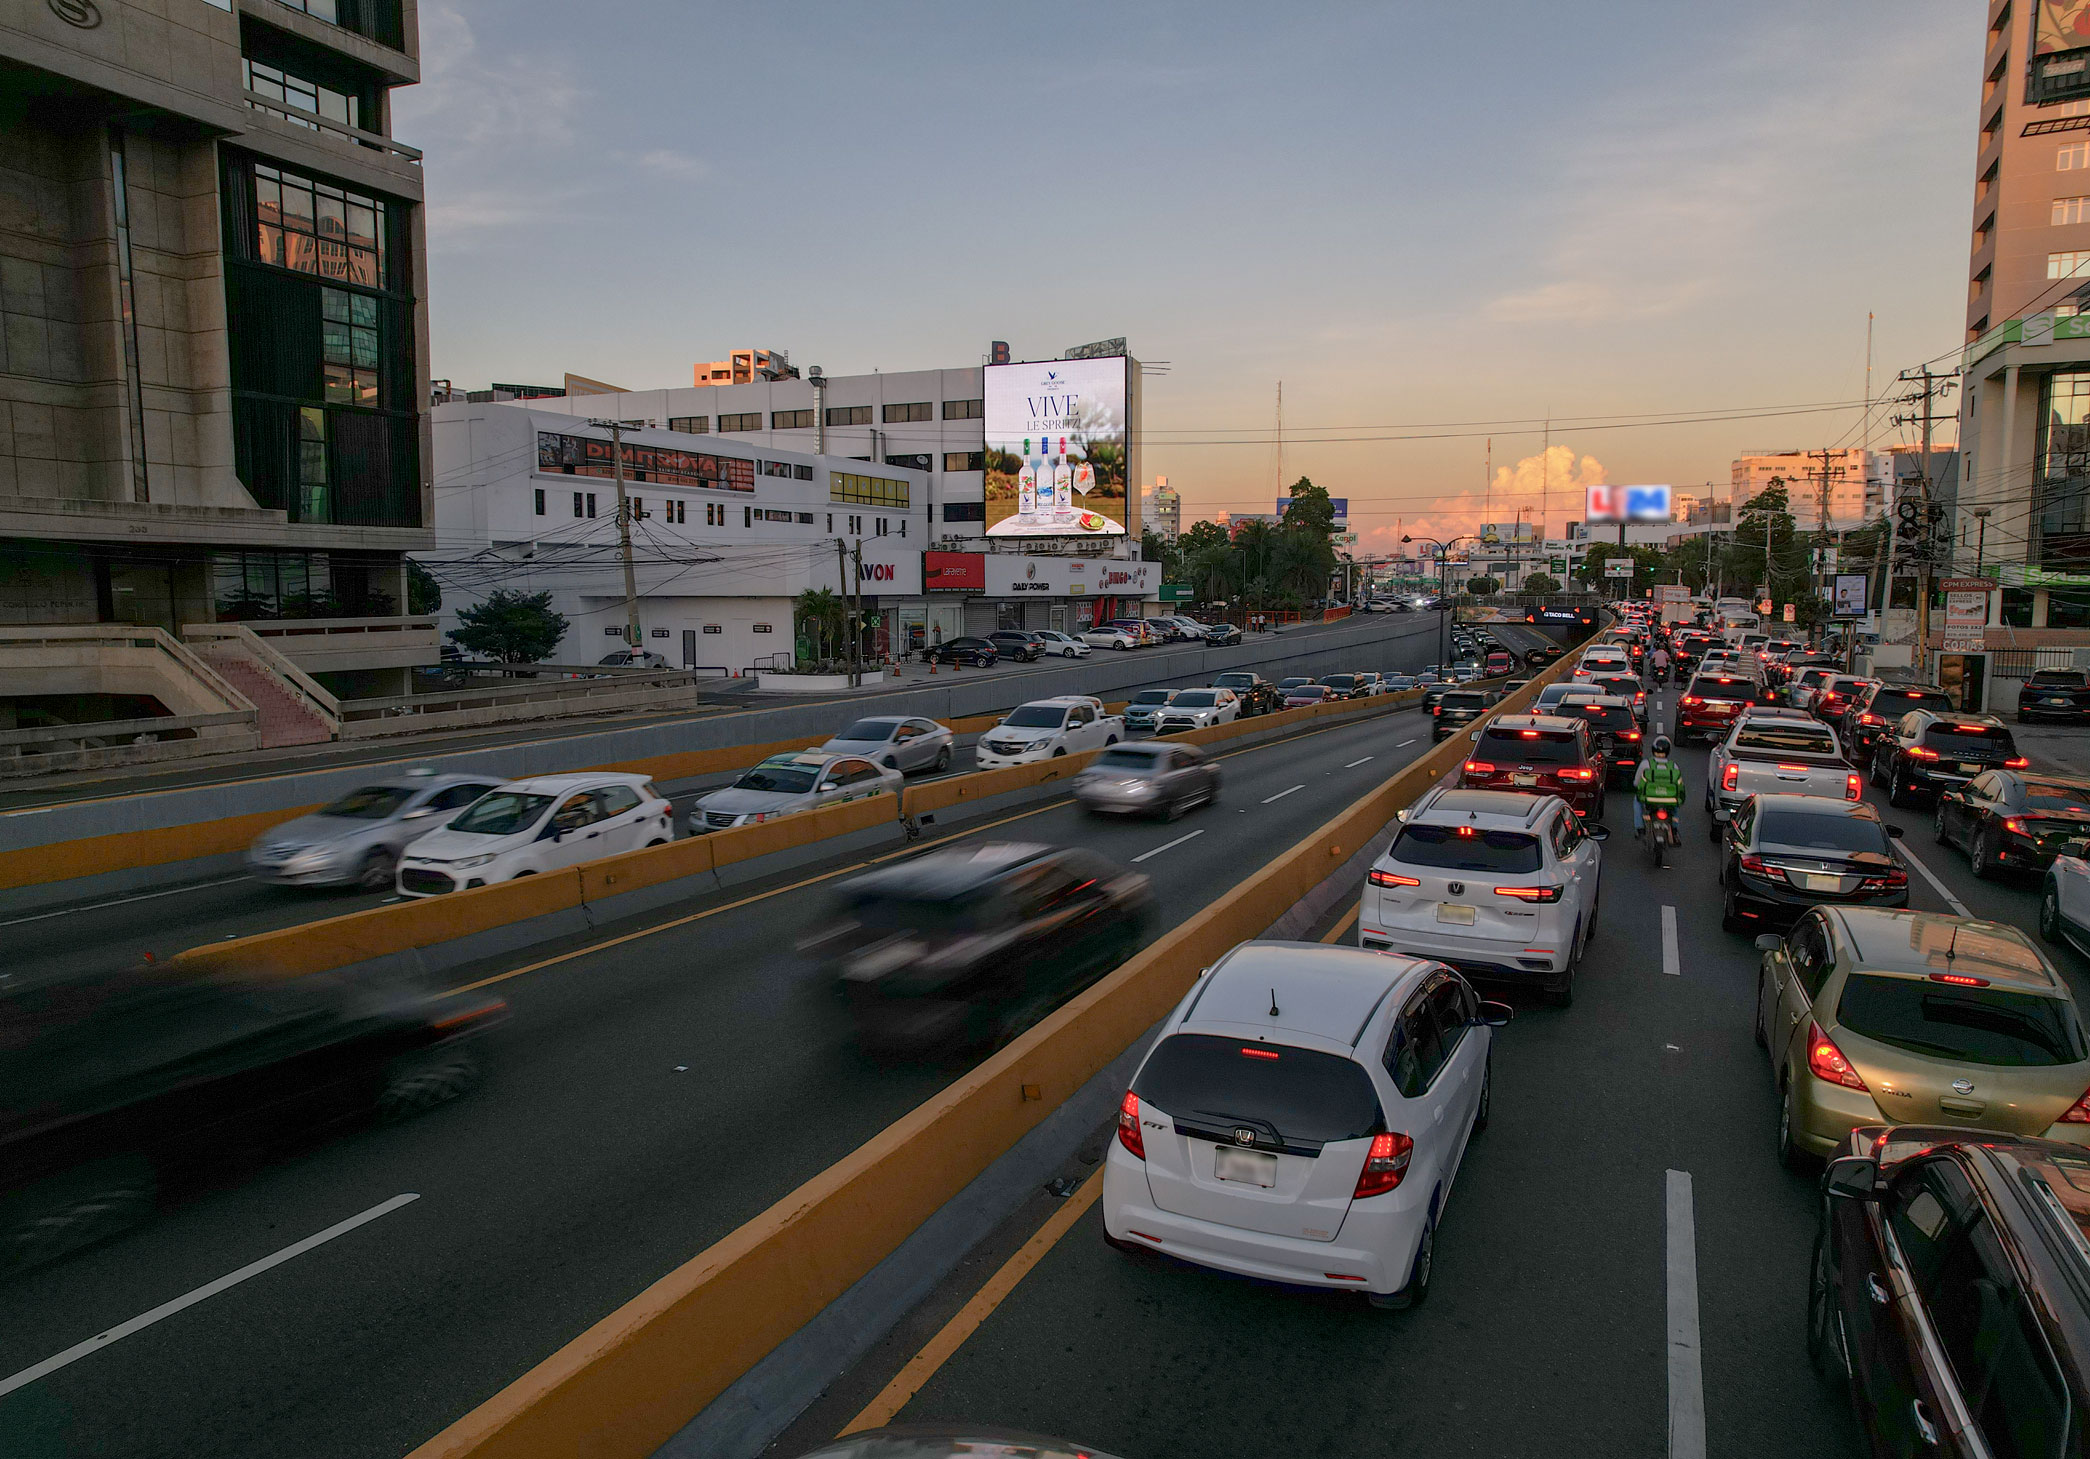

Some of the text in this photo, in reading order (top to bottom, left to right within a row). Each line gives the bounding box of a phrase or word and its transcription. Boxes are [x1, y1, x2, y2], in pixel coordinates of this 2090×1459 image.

[1027, 394, 1079, 417] VIVE
[1027, 420, 1040, 431] LE
[1943, 640, 1985, 651] COPIAS
